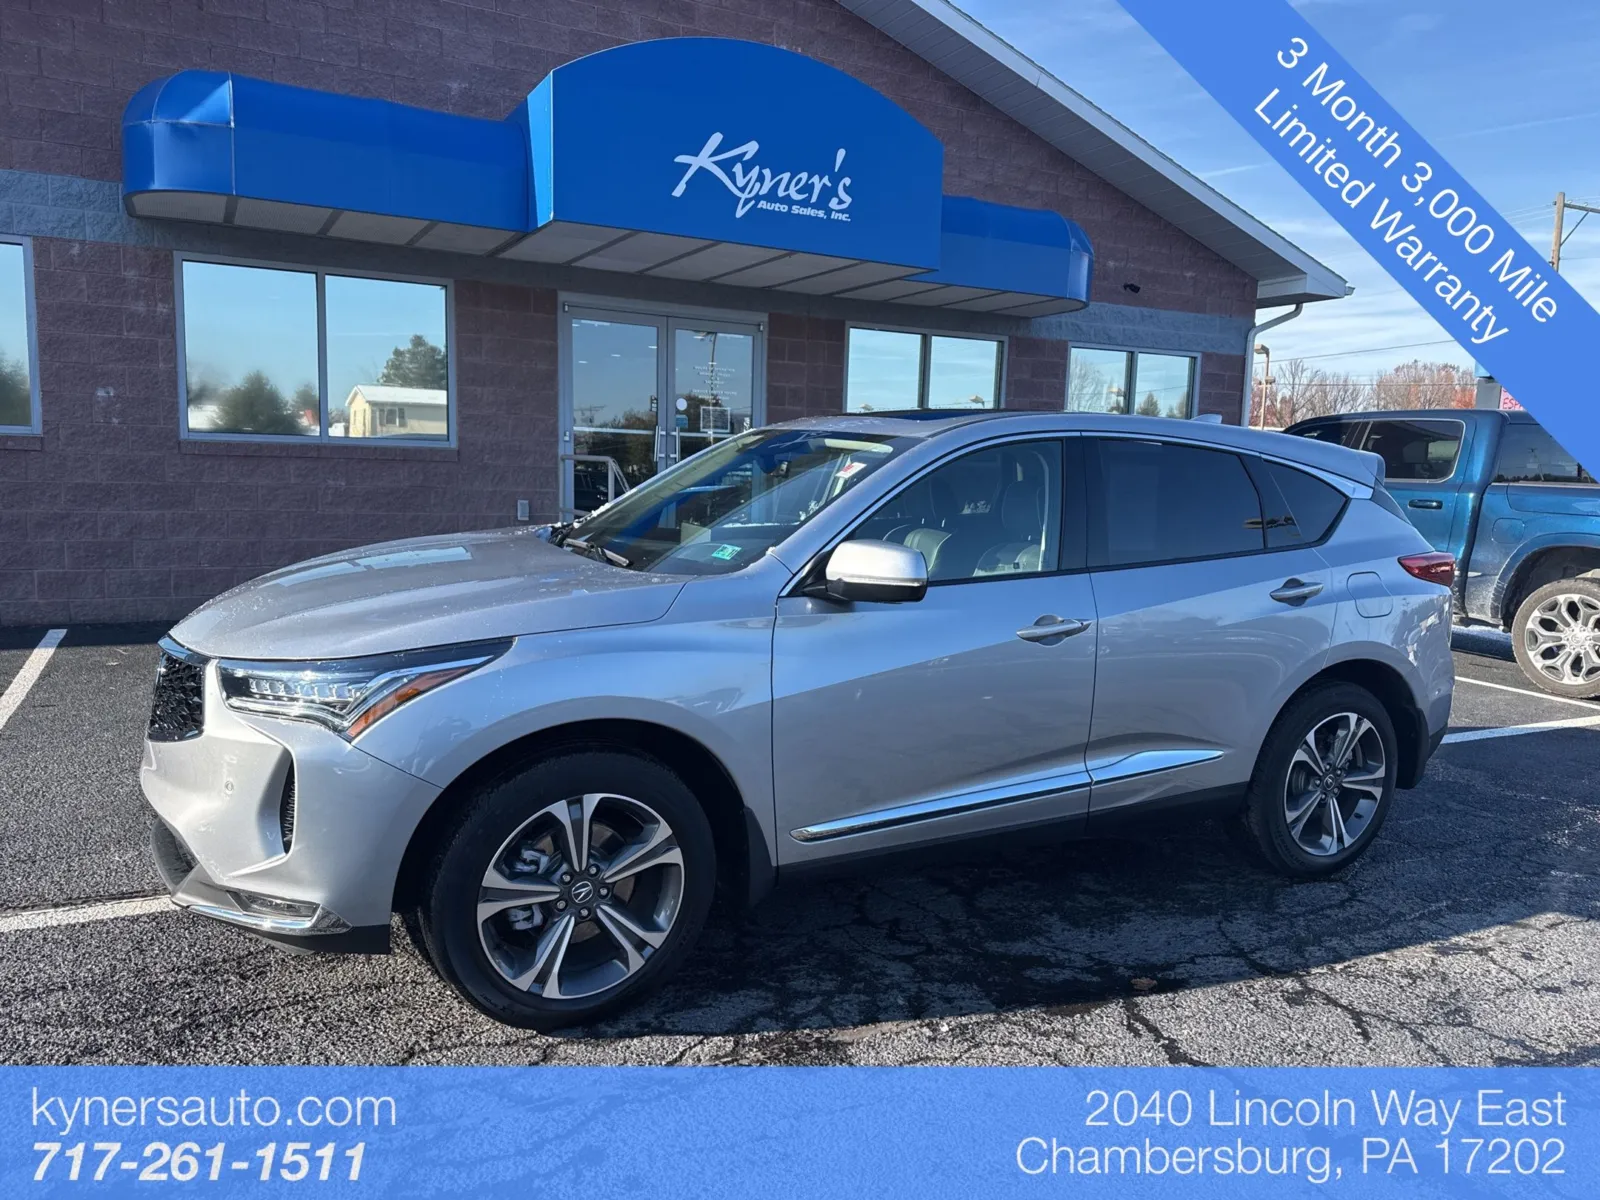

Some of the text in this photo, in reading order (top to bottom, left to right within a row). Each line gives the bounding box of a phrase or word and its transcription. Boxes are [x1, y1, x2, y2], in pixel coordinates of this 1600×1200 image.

[671, 131, 852, 219] Kyner's
[757, 200, 851, 222] Auto Sales, Inc.
